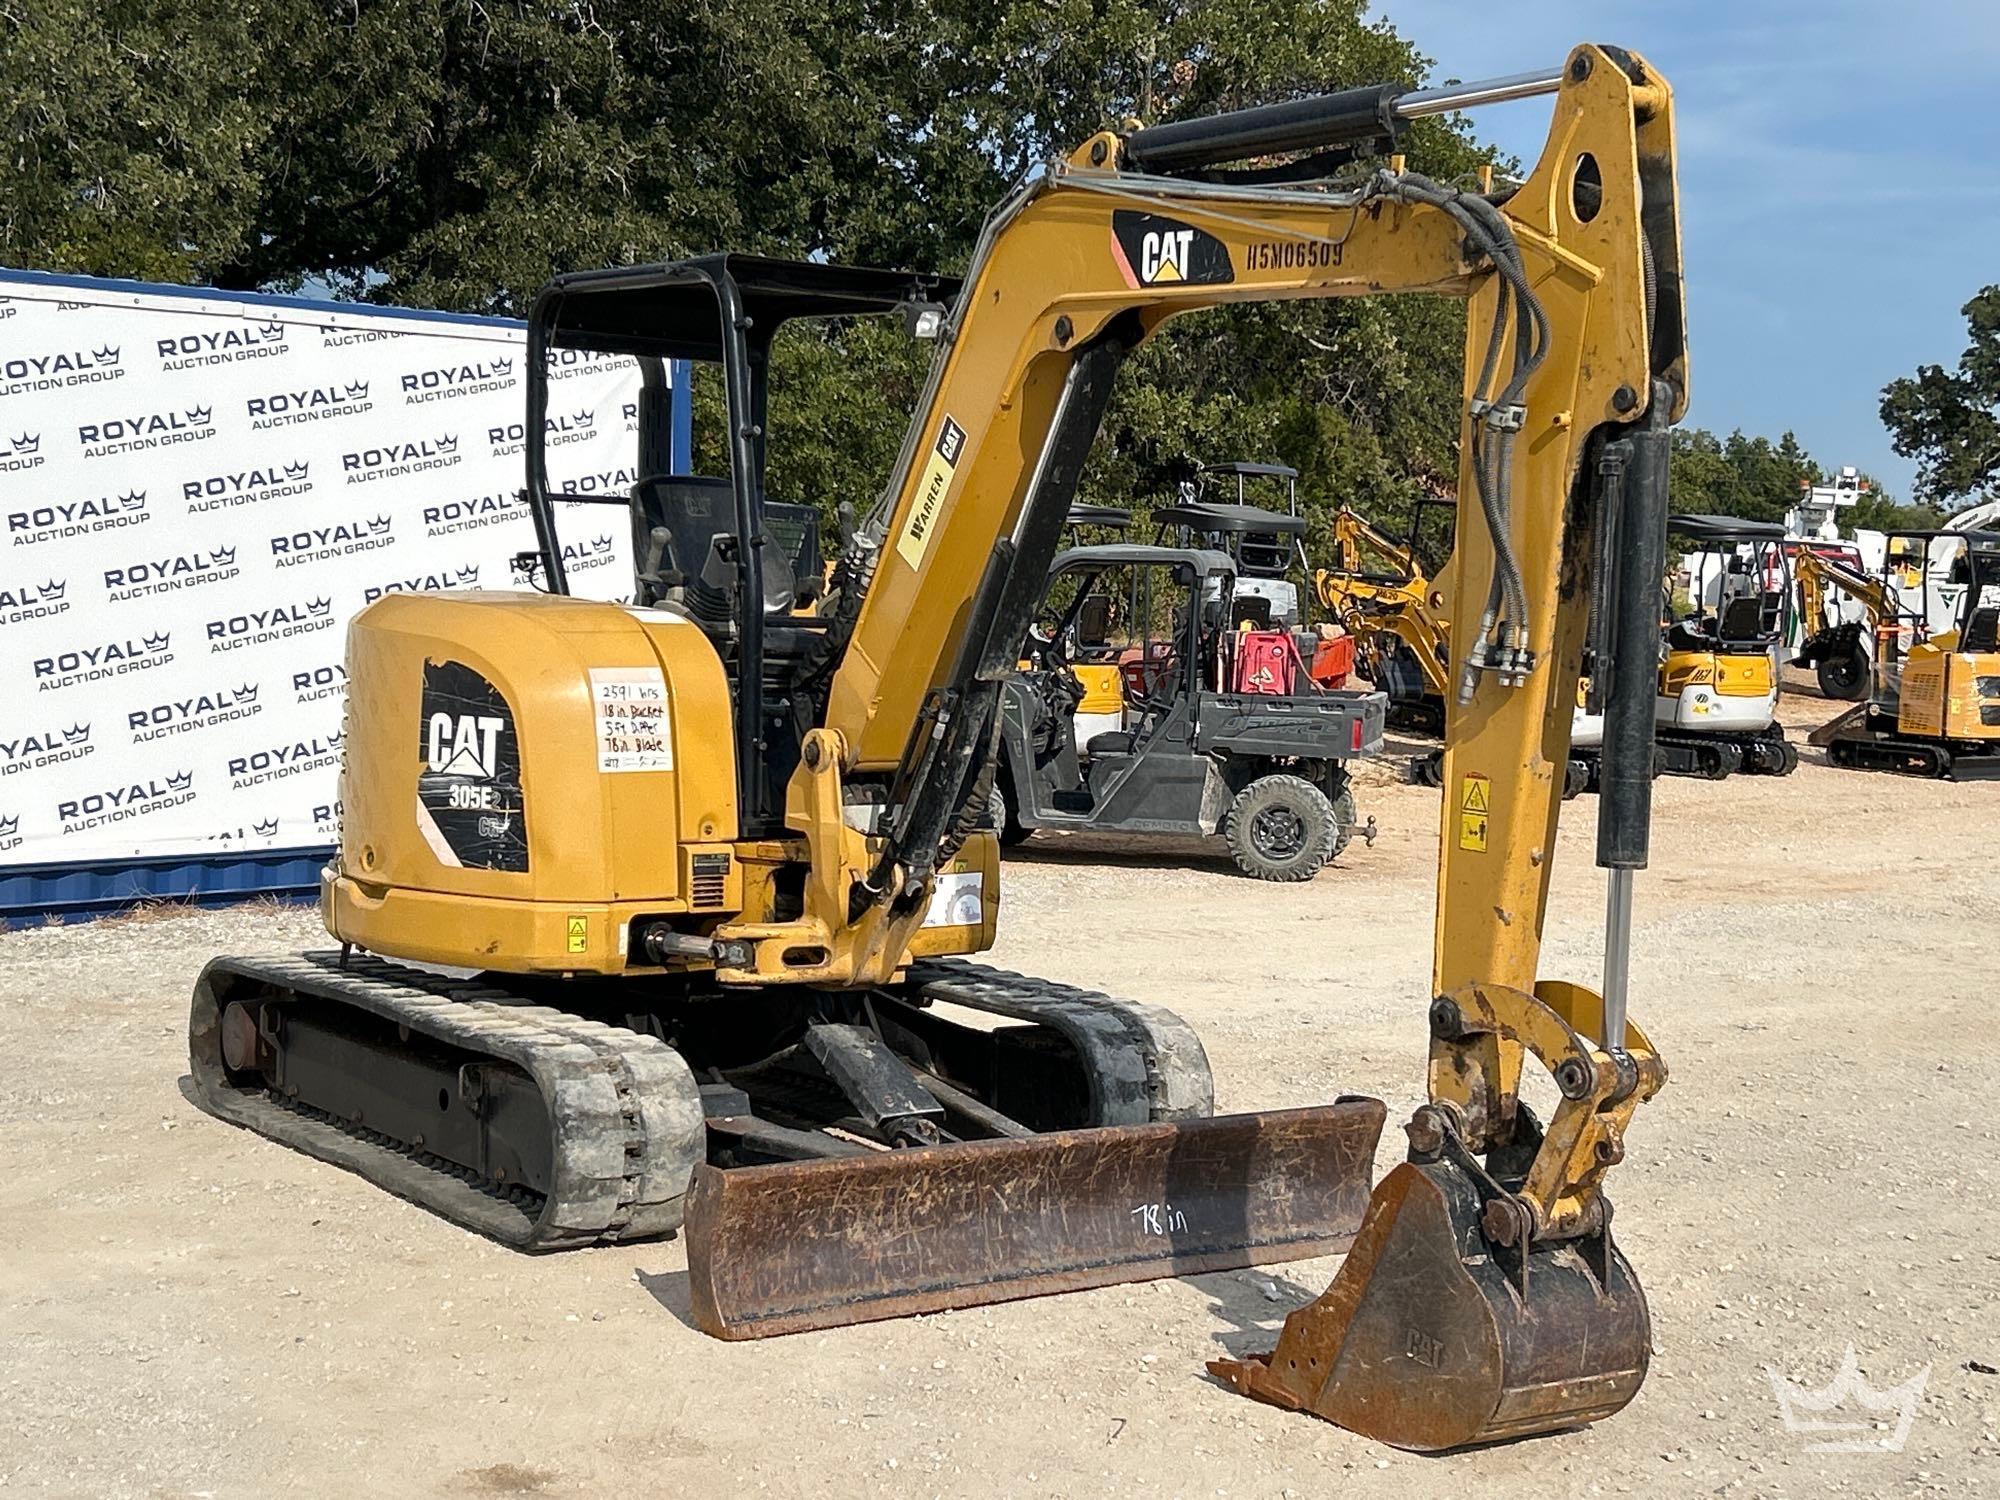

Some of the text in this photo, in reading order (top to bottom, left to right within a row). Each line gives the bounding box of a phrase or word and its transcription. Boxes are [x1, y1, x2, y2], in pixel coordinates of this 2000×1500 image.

[1141, 230, 1194, 283] CAT
[157, 329, 260, 357] ROYAL
[163, 345, 288, 371] AUCTION GROUP
[0, 352, 93, 380] OYAL
[402, 364, 491, 392] ROYAL
[605, 359, 639, 372] GROU
[0, 369, 124, 396] UCTION GROUP
[407, 379, 516, 404] AUCTION GROUP
[247, 387, 345, 416] ROYAL
[253, 403, 372, 430] AUCTION GROUP
[79, 413, 186, 444] ROYAL
[85, 429, 215, 458] AUCTION GROUP
[489, 416, 574, 445] ROAL
[553, 431, 596, 445] GROUP
[0, 457, 44, 472] ROUP
[343, 441, 435, 470] ROYAL
[347, 456, 461, 484] AUCTION GROUP
[183, 468, 284, 500] ROYAL
[910, 423, 961, 542] WARREN CAT
[188, 483, 312, 513] AUCTION GROUP
[423, 494, 512, 524] ROYAL
[8, 498, 119, 532] ROYAL
[14, 513, 150, 546] AUCTION GROUP
[428, 508, 532, 536] AUCTION GROU
[271, 523, 368, 555] ROYAL
[276, 537, 394, 568] AUCTION GROUP
[104, 554, 210, 588] ROYAL
[573, 556, 615, 572] GROUP
[110, 568, 239, 602] AUCTION GROUP
[10, 603, 69, 622] GROUP
[207, 605, 306, 640] ROYAL
[212, 618, 334, 653] AUCTION GROUP
[34, 641, 143, 678] ROYAL
[40, 654, 173, 691] AUCTION GROUP
[603, 685, 659, 700] 2591 hrs
[129, 693, 233, 730] ROYAL
[134, 705, 261, 744] AUCTION GROUP
[604, 704, 614, 717] 18
[606, 721, 614, 736] 5
[0, 733, 62, 759] YAL
[36, 746, 94, 767] GROUP
[229, 740, 327, 776] ROYAL
[428, 712, 504, 778] CAT
[605, 737, 619, 752] 78
[635, 737, 664, 752] Blade
[233, 756, 340, 790] AUCTION GROU
[58, 781, 166, 820] ROYAL
[64, 792, 196, 834] AUCTION GROUP
[1131, 1204, 1188, 1235] 78 in
[1405, 1327, 1444, 1369] CAT
